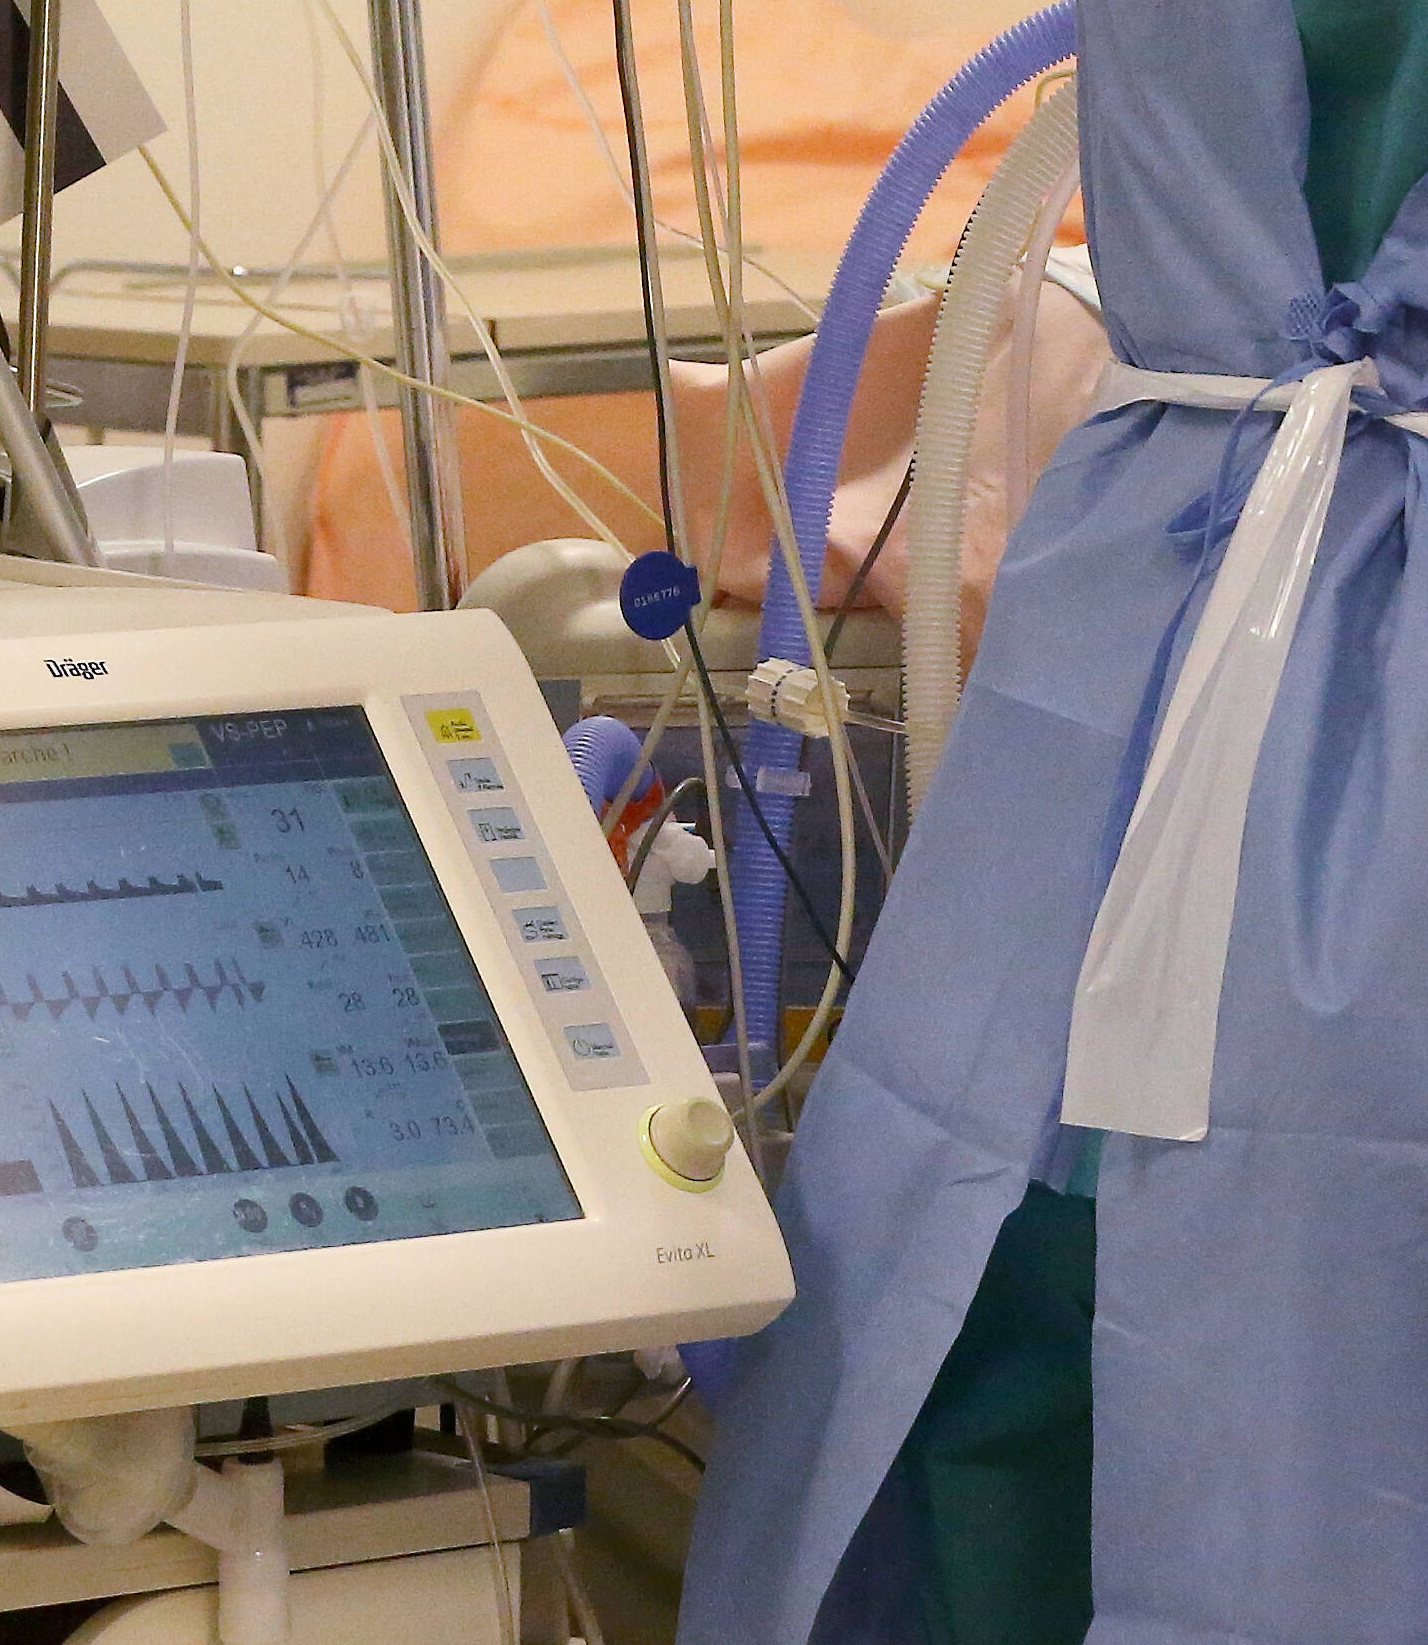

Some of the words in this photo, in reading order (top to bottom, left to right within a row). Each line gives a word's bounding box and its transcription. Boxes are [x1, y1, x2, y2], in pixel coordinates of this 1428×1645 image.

[43, 657, 109, 680] Dräger
[210, 717, 290, 742] VS-PEP
[271, 807, 305, 834] 31
[285, 864, 309, 885] 14
[392, 986, 420, 1008] 28
[656, 1247, 693, 1264] Evita
[695, 1242, 716, 1260] XL
